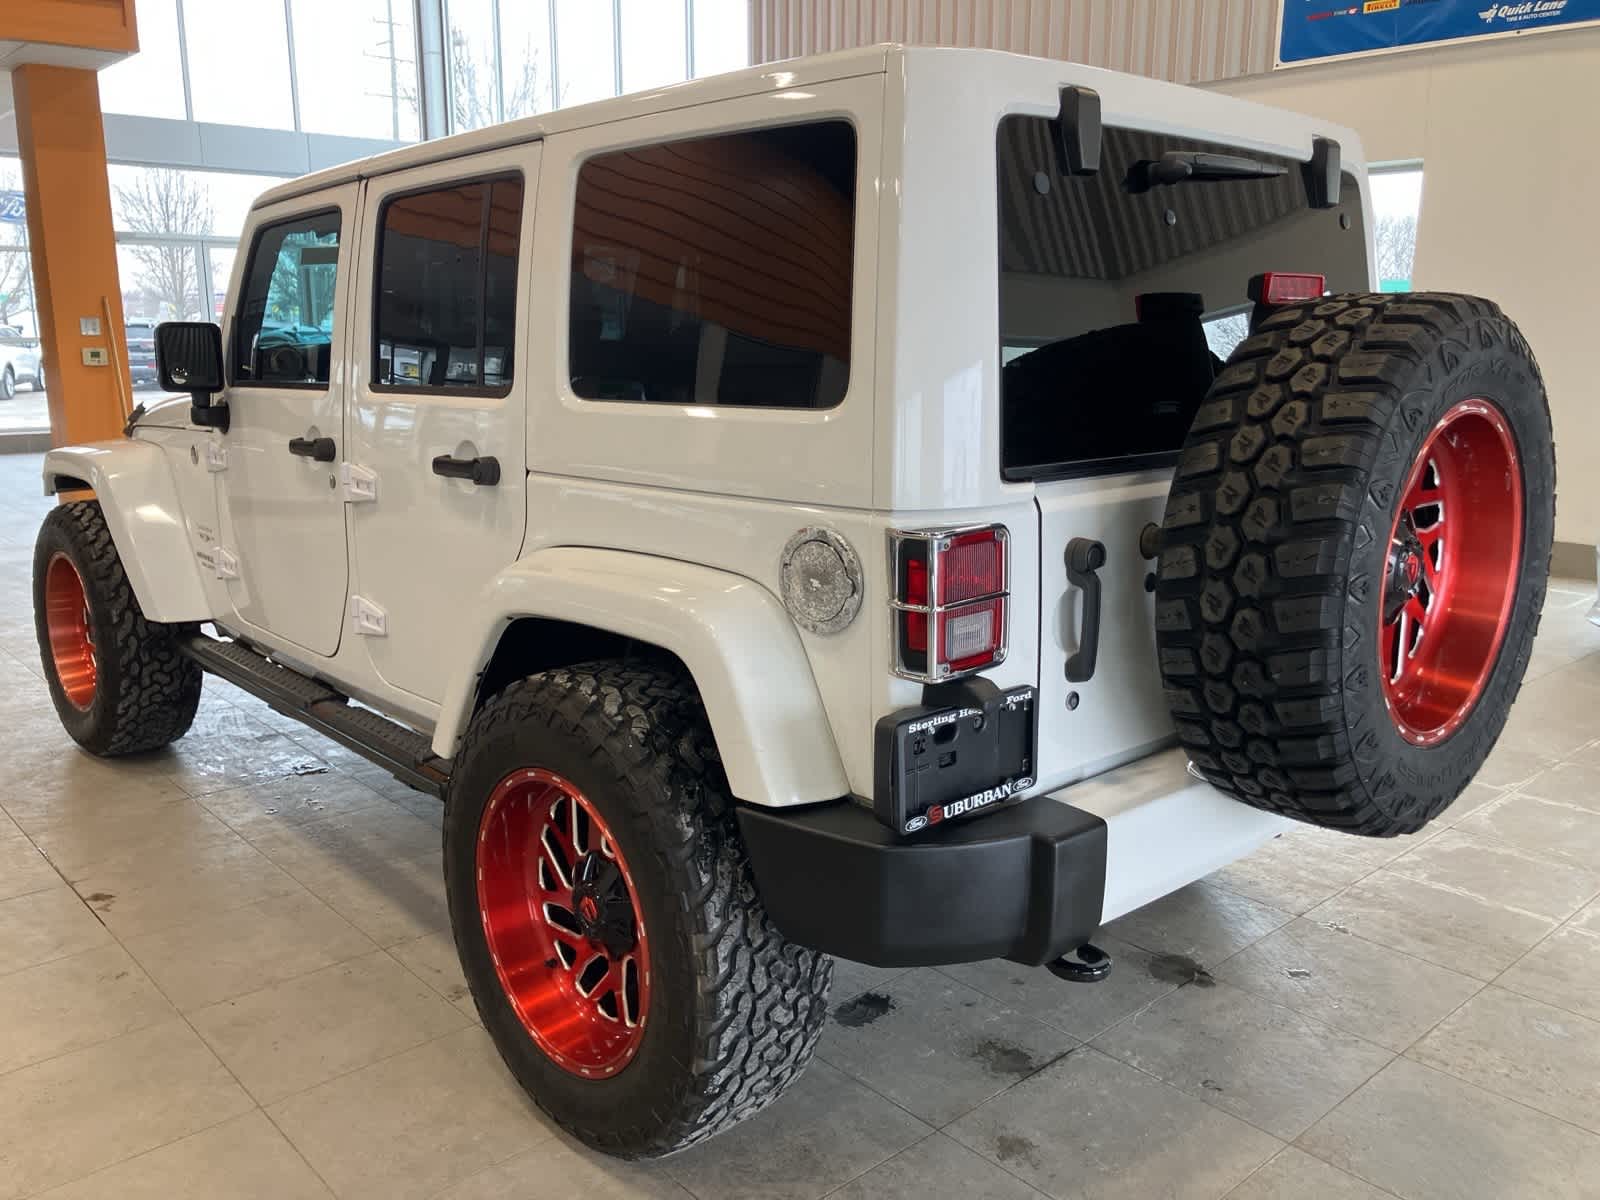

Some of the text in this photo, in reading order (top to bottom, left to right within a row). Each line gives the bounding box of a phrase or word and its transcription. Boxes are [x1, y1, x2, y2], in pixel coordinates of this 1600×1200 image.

[1498, 0, 1567, 17] Quick Lane
[1538, 10, 1561, 18] CENTER
[908, 712, 957, 733] Sterling
[1006, 691, 1032, 704] Ford
[927, 783, 1012, 825] SUBURBAN
